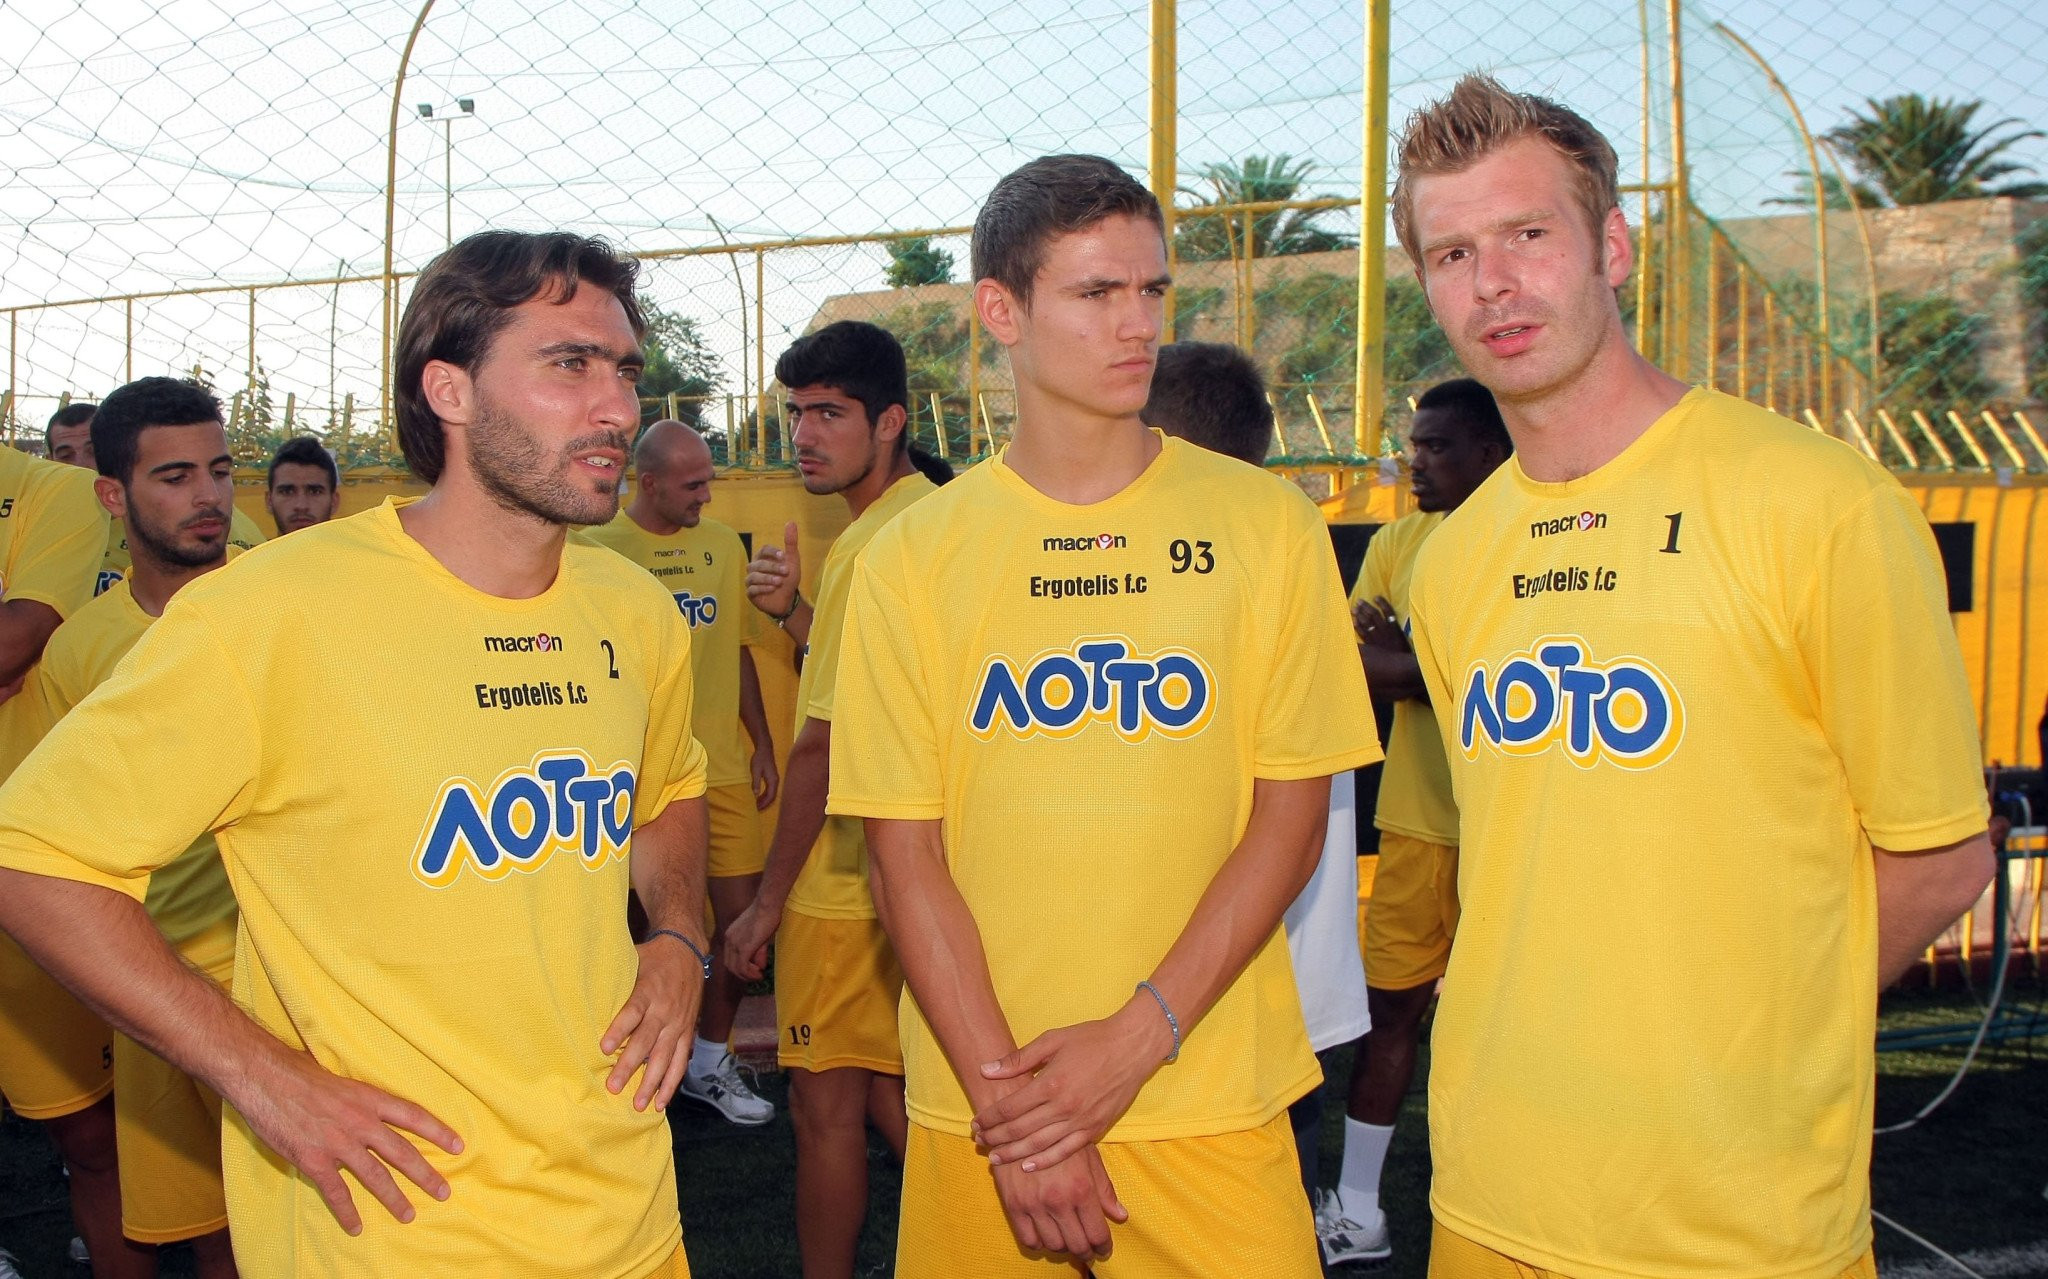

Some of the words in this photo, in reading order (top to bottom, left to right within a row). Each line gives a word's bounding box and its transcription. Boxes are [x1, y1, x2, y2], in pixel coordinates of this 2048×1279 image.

[1531, 511, 1607, 538] macron
[1658, 511, 1683, 553] 1
[1043, 533, 1127, 551] macron
[704, 552, 713, 566] 9
[1169, 538, 1215, 574] 93
[1030, 574, 1119, 599] Ergotelis
[1125, 574, 1147, 594] f.c
[1513, 566, 1589, 599] Ergotelis
[1594, 566, 1617, 591] f.c
[485, 632, 563, 652] macron
[600, 639, 620, 680] 2
[475, 681, 564, 710] Ergotelis
[567, 681, 588, 705] f.c
[787, 1024, 811, 1046] 19
